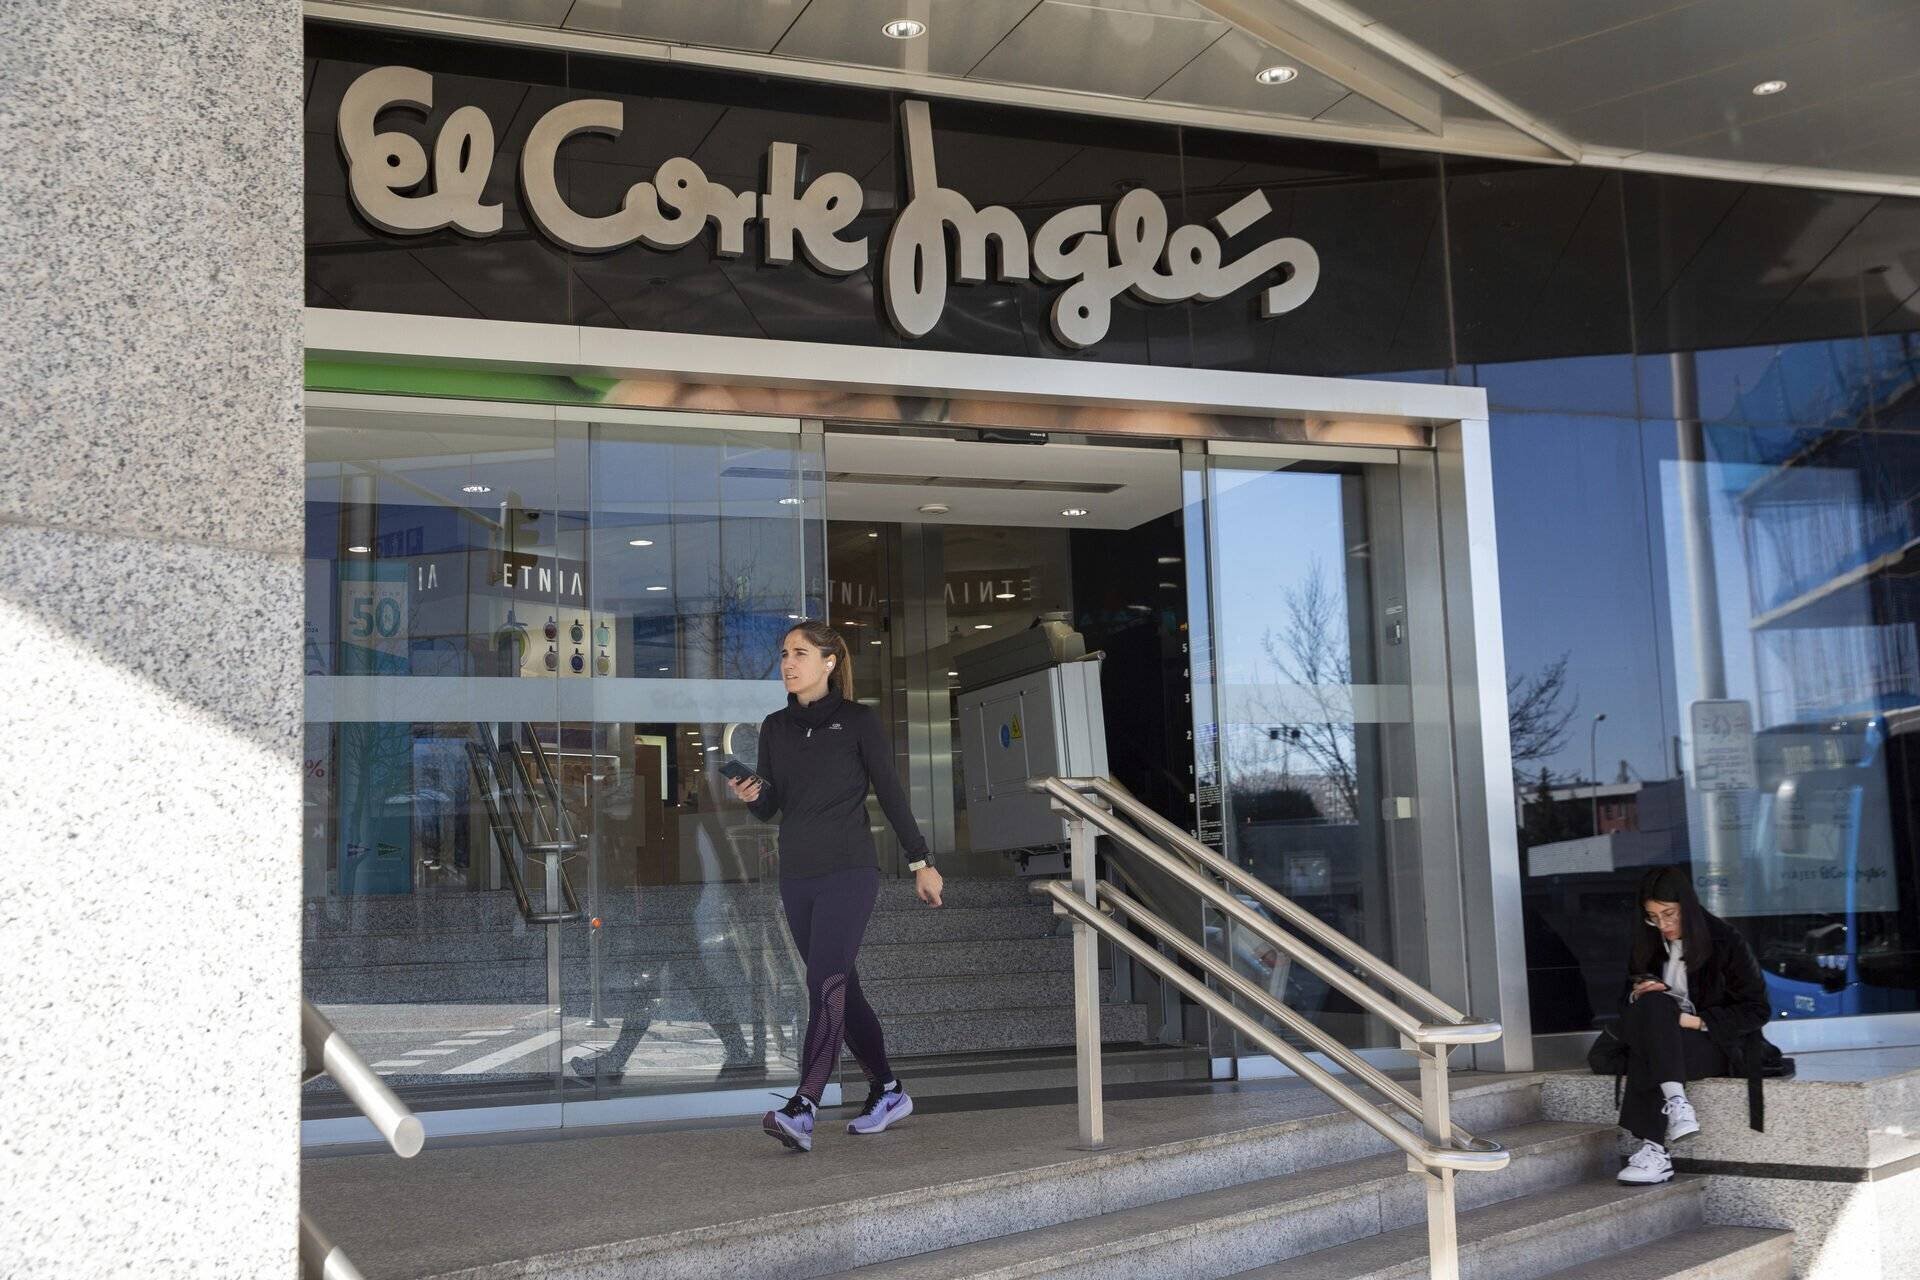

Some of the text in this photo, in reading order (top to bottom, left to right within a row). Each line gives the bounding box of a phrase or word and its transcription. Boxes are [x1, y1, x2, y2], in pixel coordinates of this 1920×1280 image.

[337, 65, 1320, 348] El Corte Inglés
[503, 563, 583, 597] ETNIA
[349, 597, 401, 638] 50
